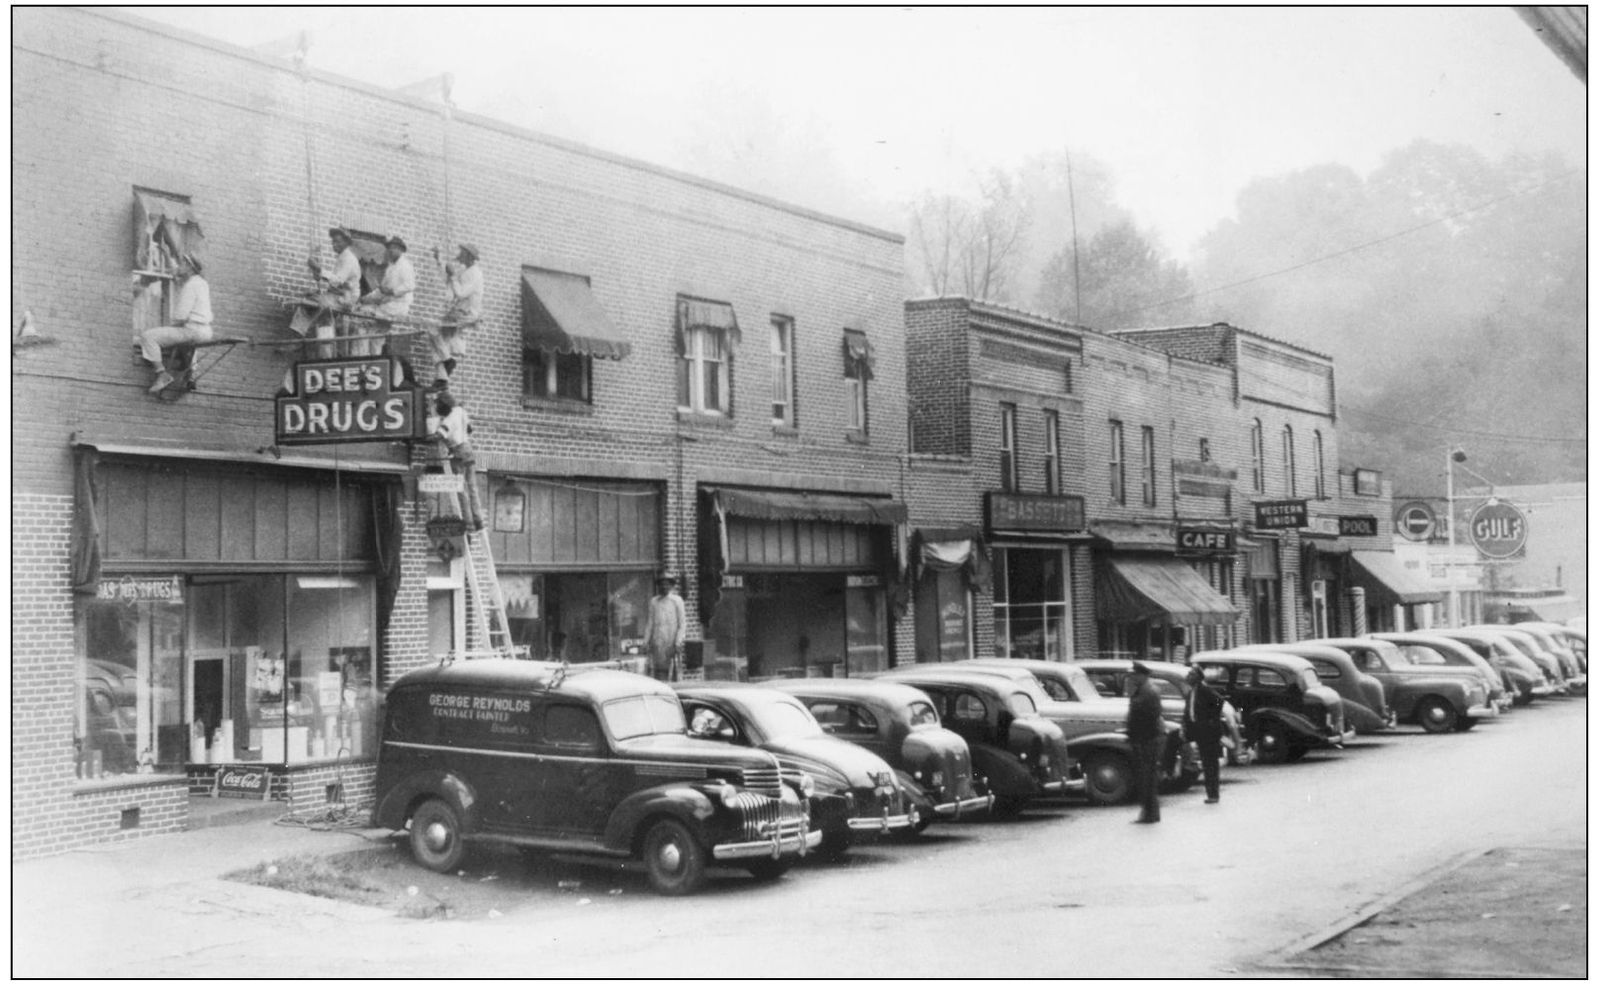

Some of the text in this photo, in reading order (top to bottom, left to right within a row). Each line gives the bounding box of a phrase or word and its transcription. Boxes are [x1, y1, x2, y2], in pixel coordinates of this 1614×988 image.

[305, 364, 382, 393] DEE'S
[284, 398, 404, 434] DRUGS
[1260, 504, 1304, 515] WESTERN
[1266, 515, 1297, 526] UNION
[1343, 520, 1374, 534] POOL
[1477, 518, 1521, 540] GULF
[1182, 532, 1227, 548] CAFE
[429, 694, 531, 712] GEORGE REYNOLDS
[222, 771, 262, 789] Coca-Cola
